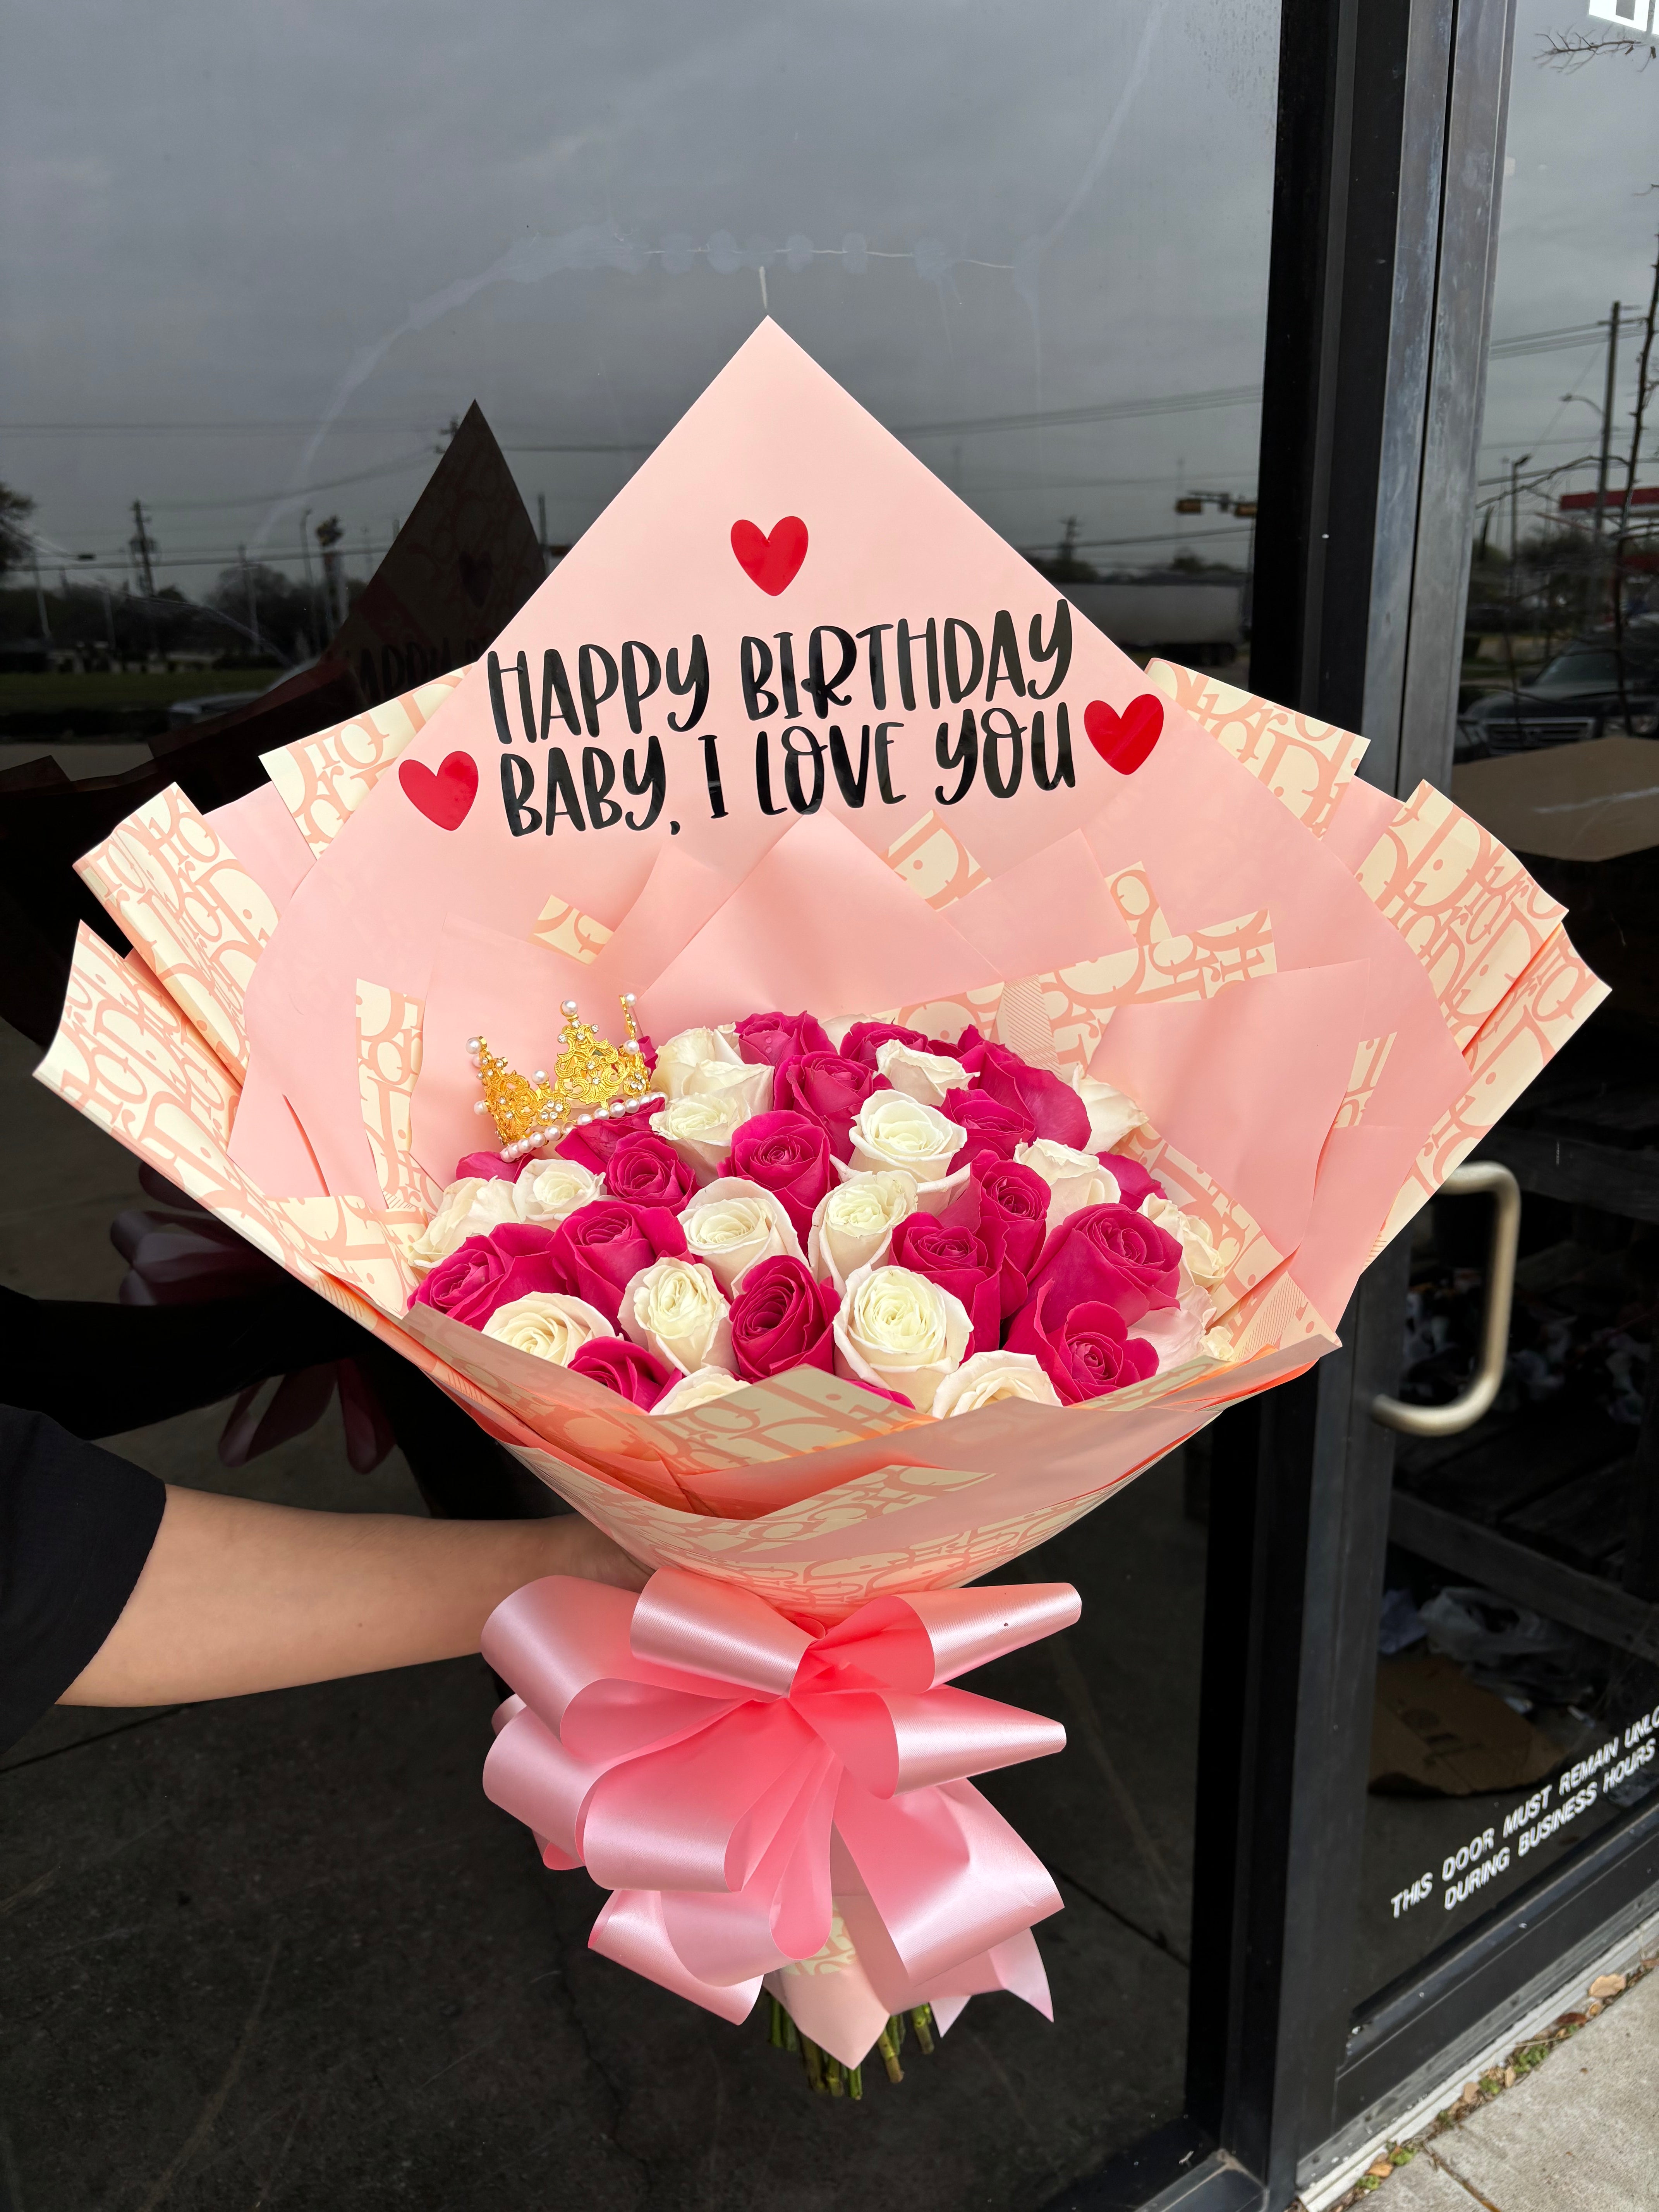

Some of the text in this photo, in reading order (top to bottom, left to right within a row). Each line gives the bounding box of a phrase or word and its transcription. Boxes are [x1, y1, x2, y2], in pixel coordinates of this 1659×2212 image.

[488, 634, 709, 744] HAPPY
[740, 599, 1072, 720] BIRTHDAY
[501, 736, 680, 836] BABY,
[698, 735, 728, 818] I
[756, 722, 906, 815] LOVE
[935, 702, 1075, 805] YOU
[1391, 1872, 1433, 1918] THIS
[1442, 1828, 1494, 1881] DOOR
[1503, 1784, 1552, 1838] MUST
[1559, 1737, 1619, 1796] REMAIN
[1444, 1738, 1656, 1910] DURING BUSINESS HOURS
